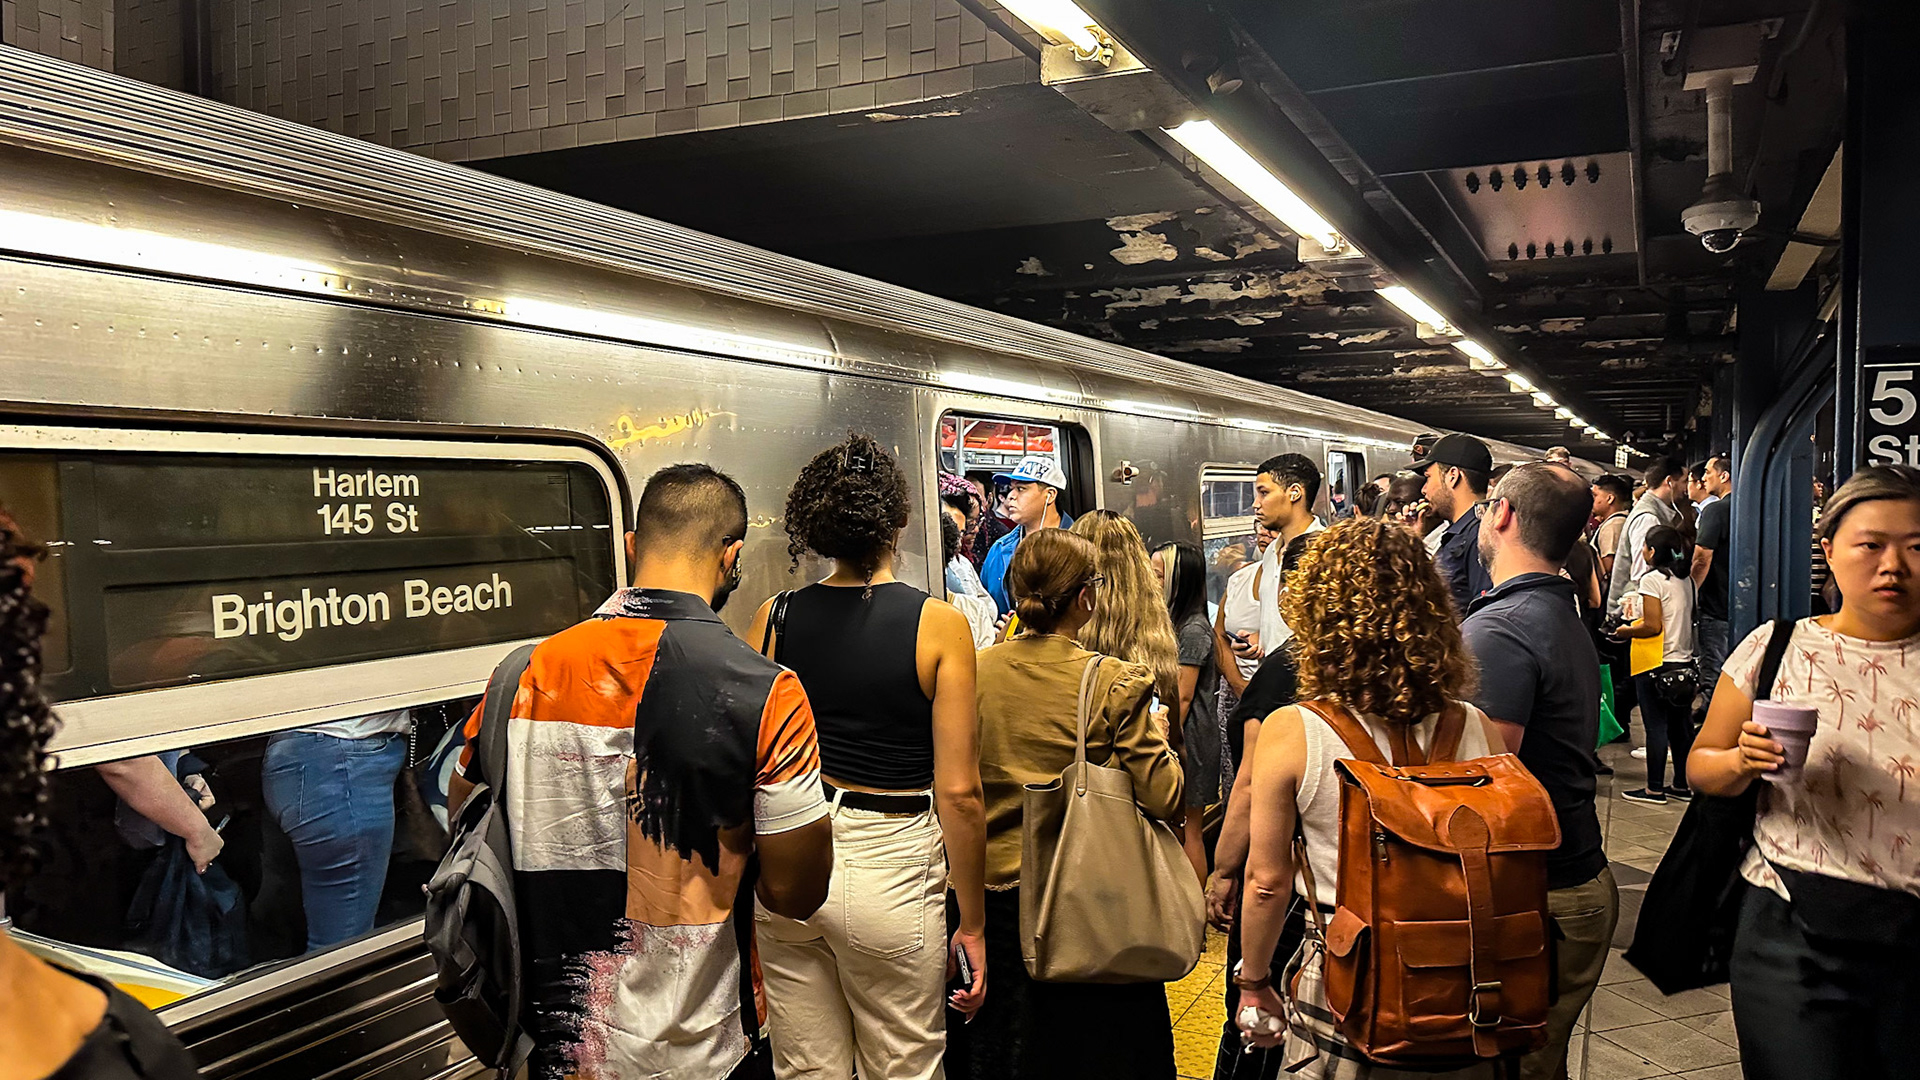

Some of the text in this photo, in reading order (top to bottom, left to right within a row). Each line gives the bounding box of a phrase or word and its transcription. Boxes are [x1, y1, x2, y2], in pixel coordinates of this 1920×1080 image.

[1868, 434, 1920, 470] St
[312, 466, 420, 497] Harlem
[316, 502, 420, 535] 145 St
[211, 572, 514, 642] Brighton Beach
